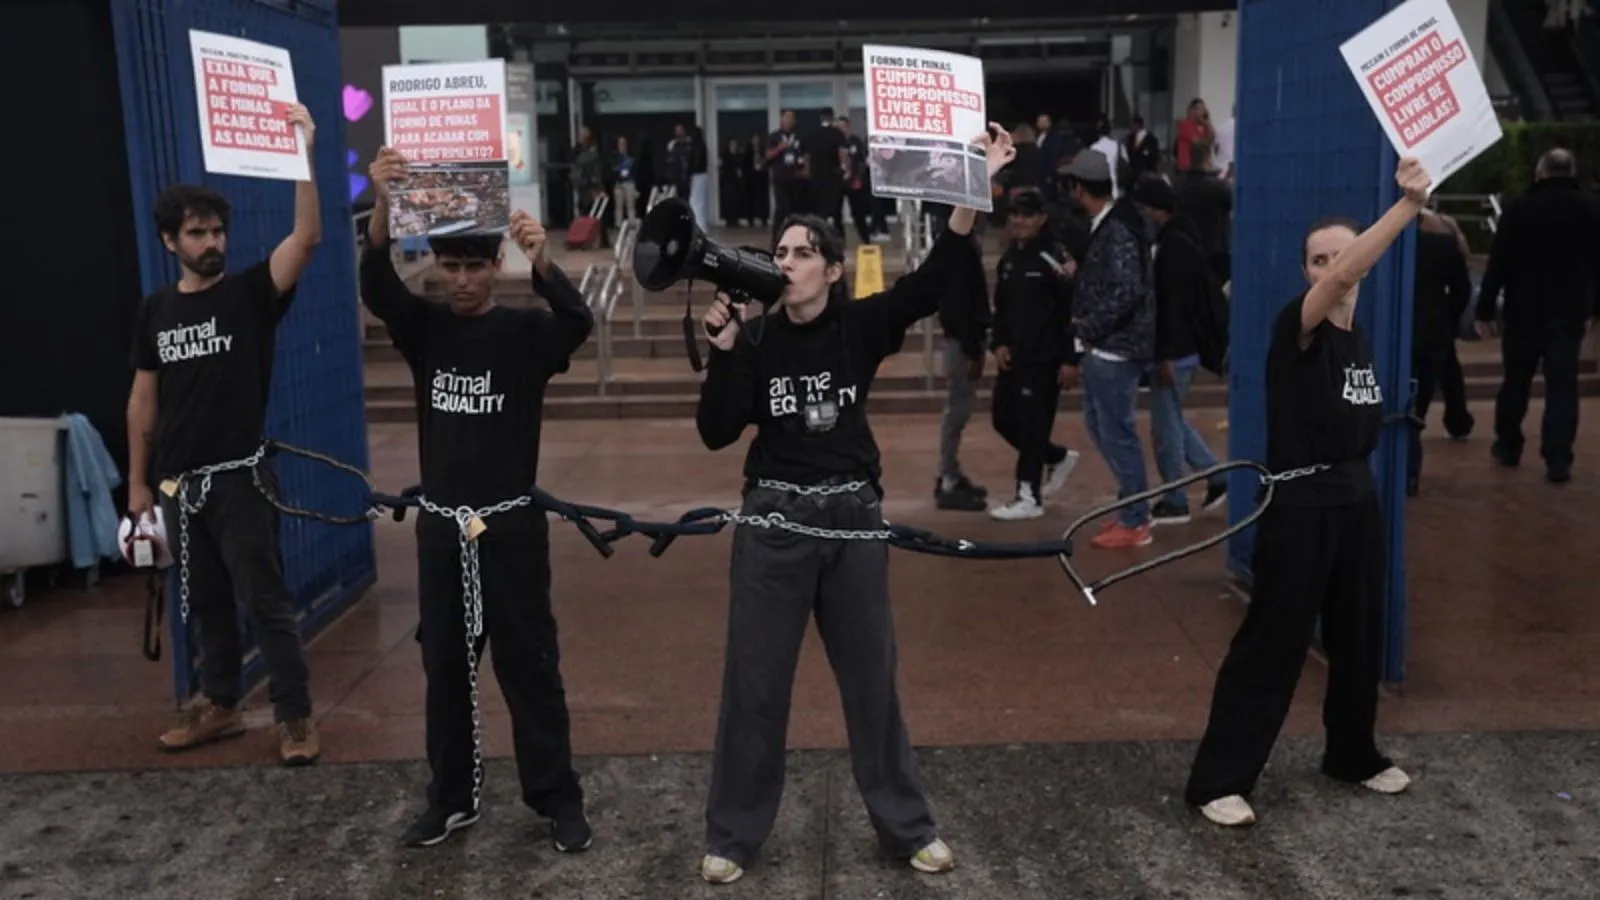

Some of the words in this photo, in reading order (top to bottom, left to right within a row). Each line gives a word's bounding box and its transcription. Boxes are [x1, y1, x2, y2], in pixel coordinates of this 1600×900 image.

[206, 60, 246, 79] EXIJA
[870, 55, 904, 67] FORNO
[906, 57, 918, 68] DE
[921, 59, 953, 71] MINAS
[1373, 45, 1433, 91] CUMPRAM
[1430, 36, 1443, 51] O
[389, 78, 441, 92] RODRIGO
[444, 75, 488, 90] ABREU,
[876, 69, 937, 86] CUMPRA
[940, 74, 951, 87] O
[1383, 45, 1463, 108] COMPROMISSO
[208, 78, 219, 91] A
[221, 80, 265, 97] FORNO
[877, 85, 979, 109] COMPROMISSO
[210, 94, 229, 110] DE
[231, 97, 272, 114] MINAS
[392, 100, 418, 115] QUAL
[429, 99, 438, 111] O
[440, 98, 475, 110] PLANO
[476, 97, 491, 109] DA
[877, 100, 921, 116] LIVRE
[925, 103, 945, 117] DE
[1392, 92, 1431, 125] LIVRE
[1427, 81, 1446, 101] DE
[212, 111, 256, 131] ACABE
[259, 117, 287, 133] COM
[393, 117, 426, 129] FORNO
[428, 115, 442, 127] DE
[444, 114, 478, 126] MINAS
[879, 115, 949, 133] GAIOLAS!
[1402, 98, 1455, 141] GAIOLAS!
[215, 129, 232, 144] AS
[235, 132, 296, 151] GAIOLAS!
[393, 131, 420, 144] PARA
[423, 130, 465, 143] ACABAR
[467, 129, 490, 141] COM
[421, 145, 494, 160] SOFRIMENTO?
[157, 316, 216, 347] animal
[158, 334, 233, 363] EQUALITY
[432, 367, 491, 394] animal
[432, 389, 505, 413] EQUALITY
